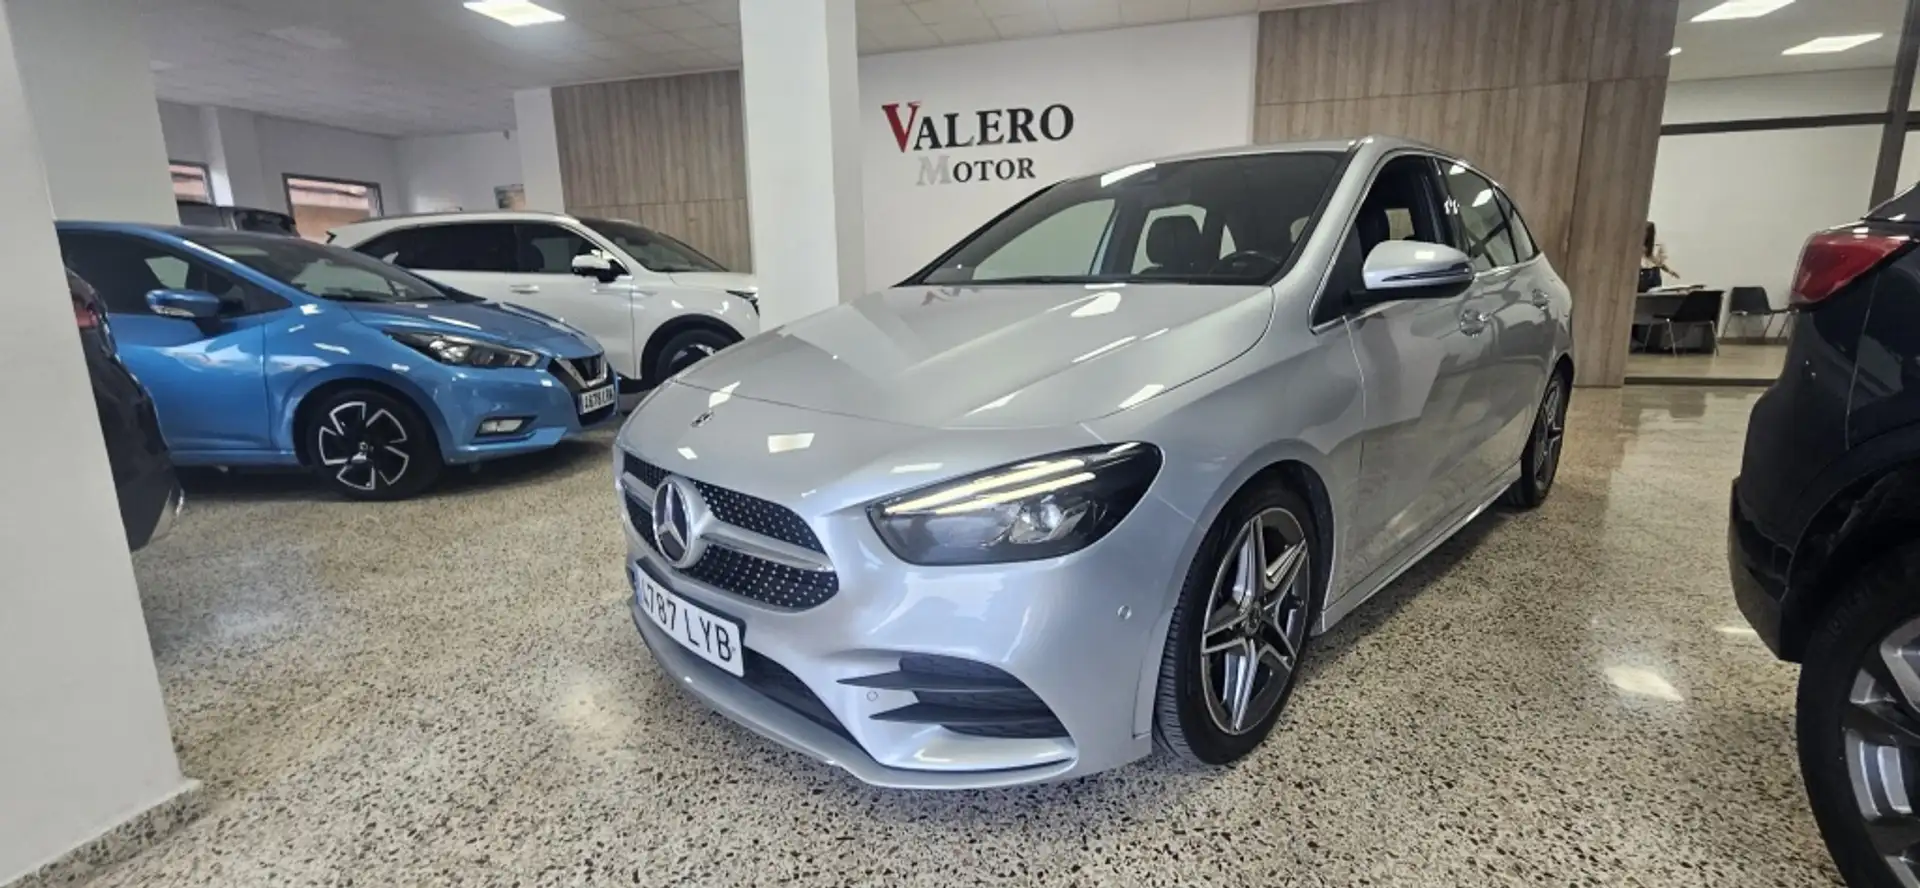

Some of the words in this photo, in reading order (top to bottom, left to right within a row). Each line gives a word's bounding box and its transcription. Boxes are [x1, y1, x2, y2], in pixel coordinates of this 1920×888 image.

[881, 101, 1074, 153] VALERO
[916, 155, 1036, 186] MOTOR
[641, 577, 677, 631] 4787
[683, 607, 732, 662] LYB
